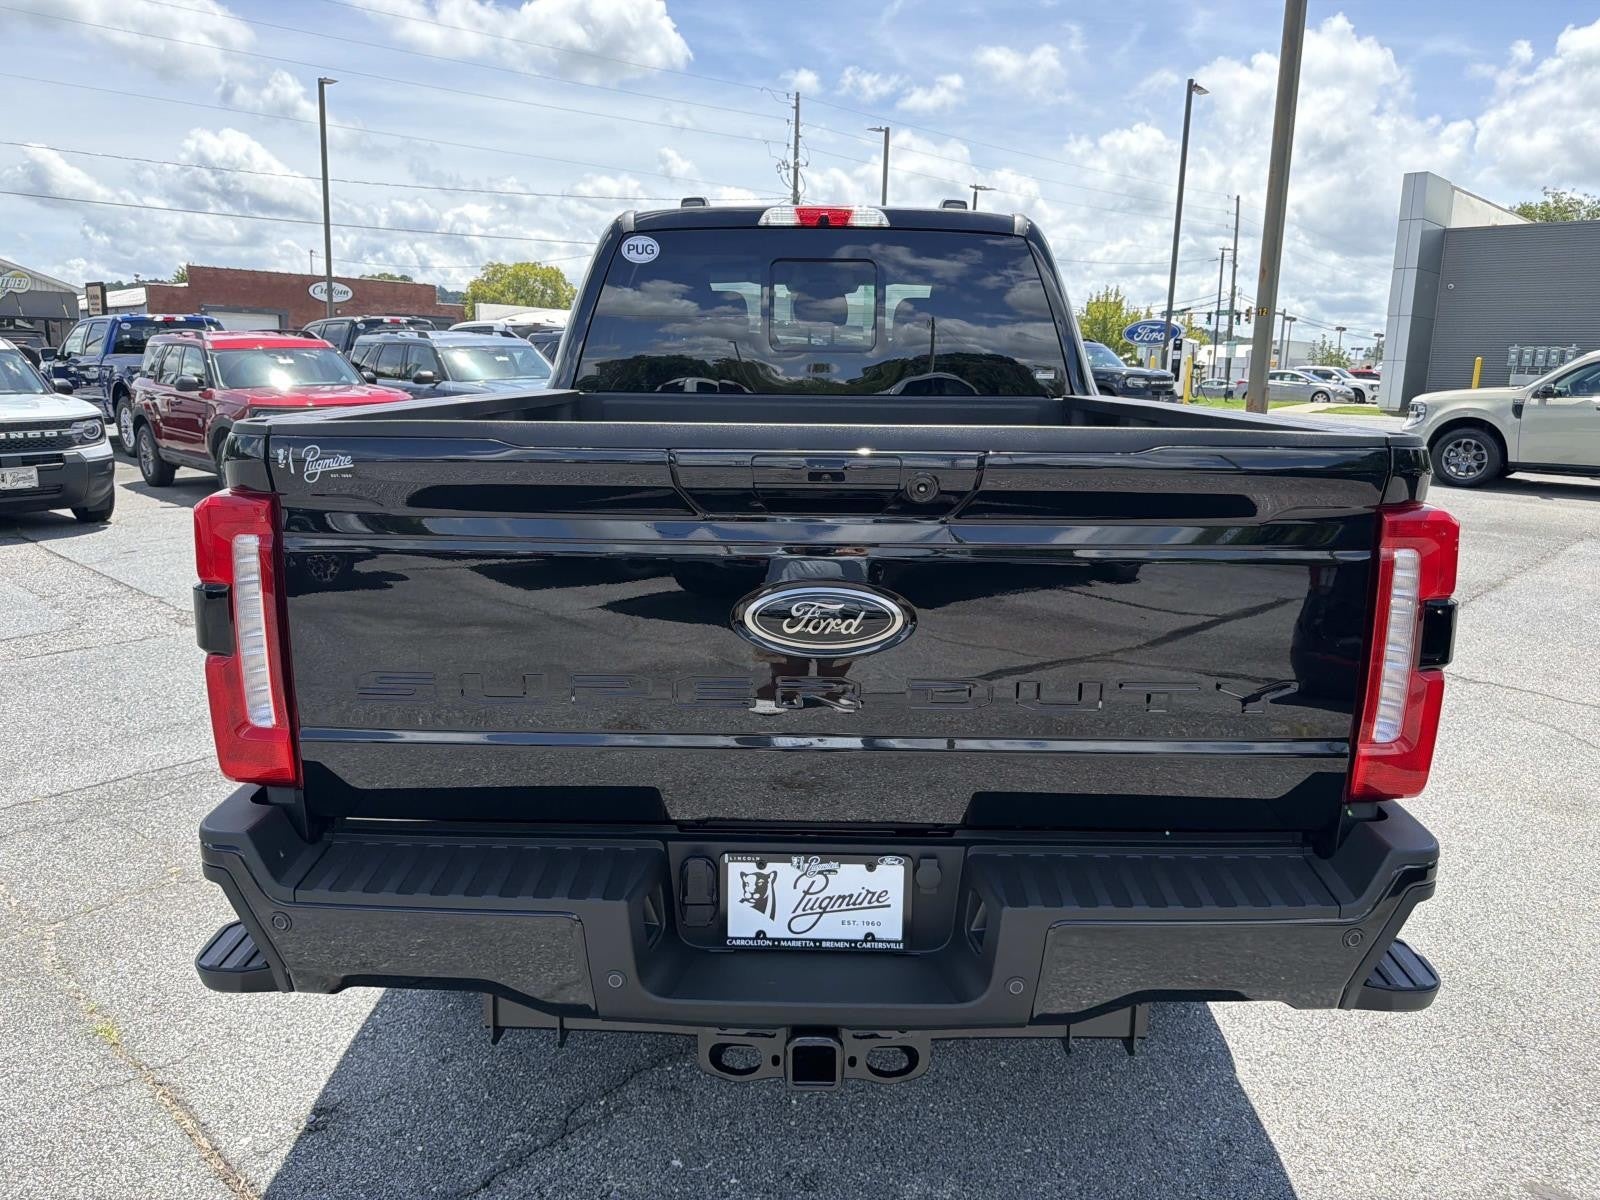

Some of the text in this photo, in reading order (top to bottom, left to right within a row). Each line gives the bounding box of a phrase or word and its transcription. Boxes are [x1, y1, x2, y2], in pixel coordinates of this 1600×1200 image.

[627, 243, 655, 255] PUG
[1258, 308, 1267, 316] 12
[302, 444, 355, 483] Pugmire
[782, 601, 866, 635] Ford
[356, 669, 1300, 714] SUPER DUTY
[787, 872, 892, 935] Pugmire
[727, 938, 773, 947] CARROLLTON
[780, 939, 815, 948] MARIETTA
[856, 941, 904, 950] CARTERSVILLE
